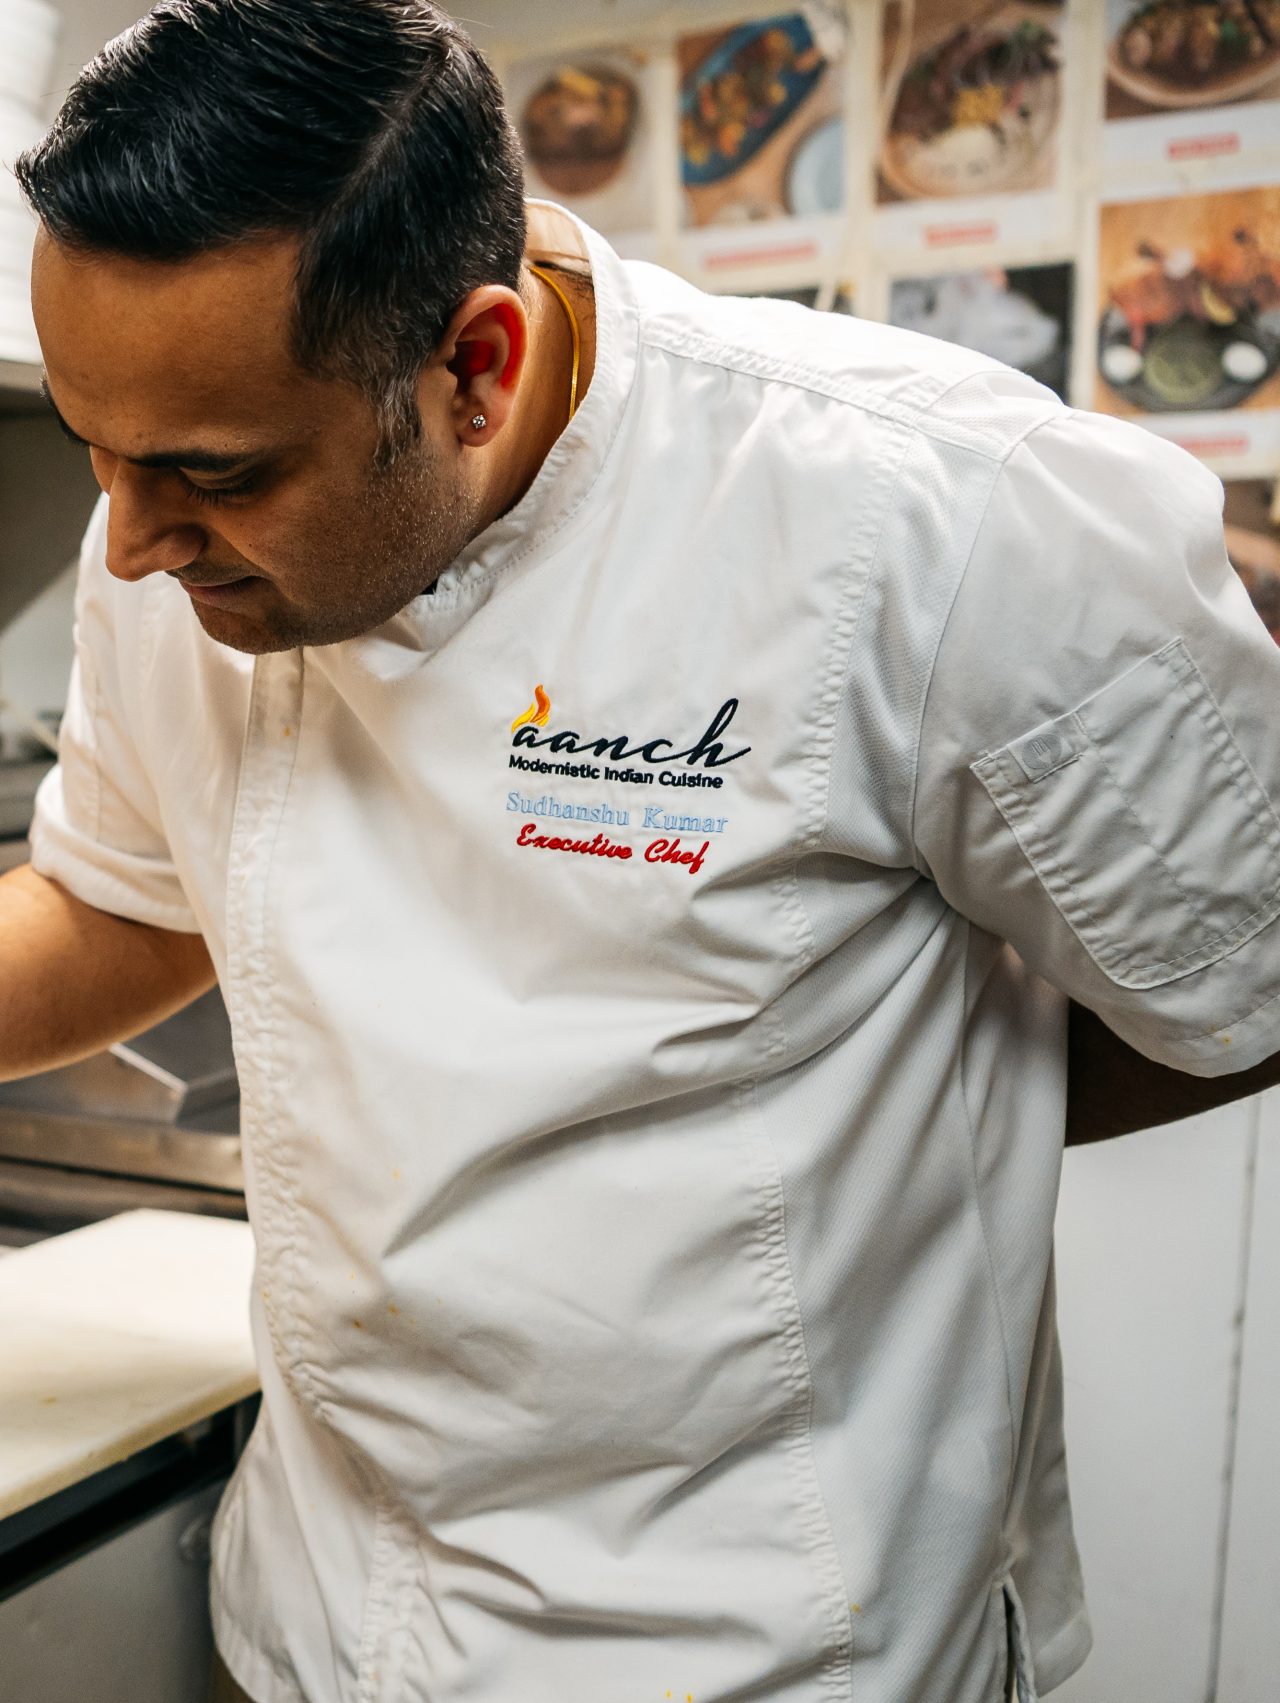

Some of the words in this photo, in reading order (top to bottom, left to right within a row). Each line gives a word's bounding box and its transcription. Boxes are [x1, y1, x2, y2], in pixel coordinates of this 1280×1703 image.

[511, 697, 752, 768] aanch
[509, 755, 600, 780] Modernistic
[604, 767, 653, 784] Indian
[659, 771, 724, 789] Cuisine
[506, 791, 630, 825] Sudhanshu
[642, 806, 728, 833] Kumar
[517, 823, 632, 860] Executive
[645, 839, 709, 874] Chef
